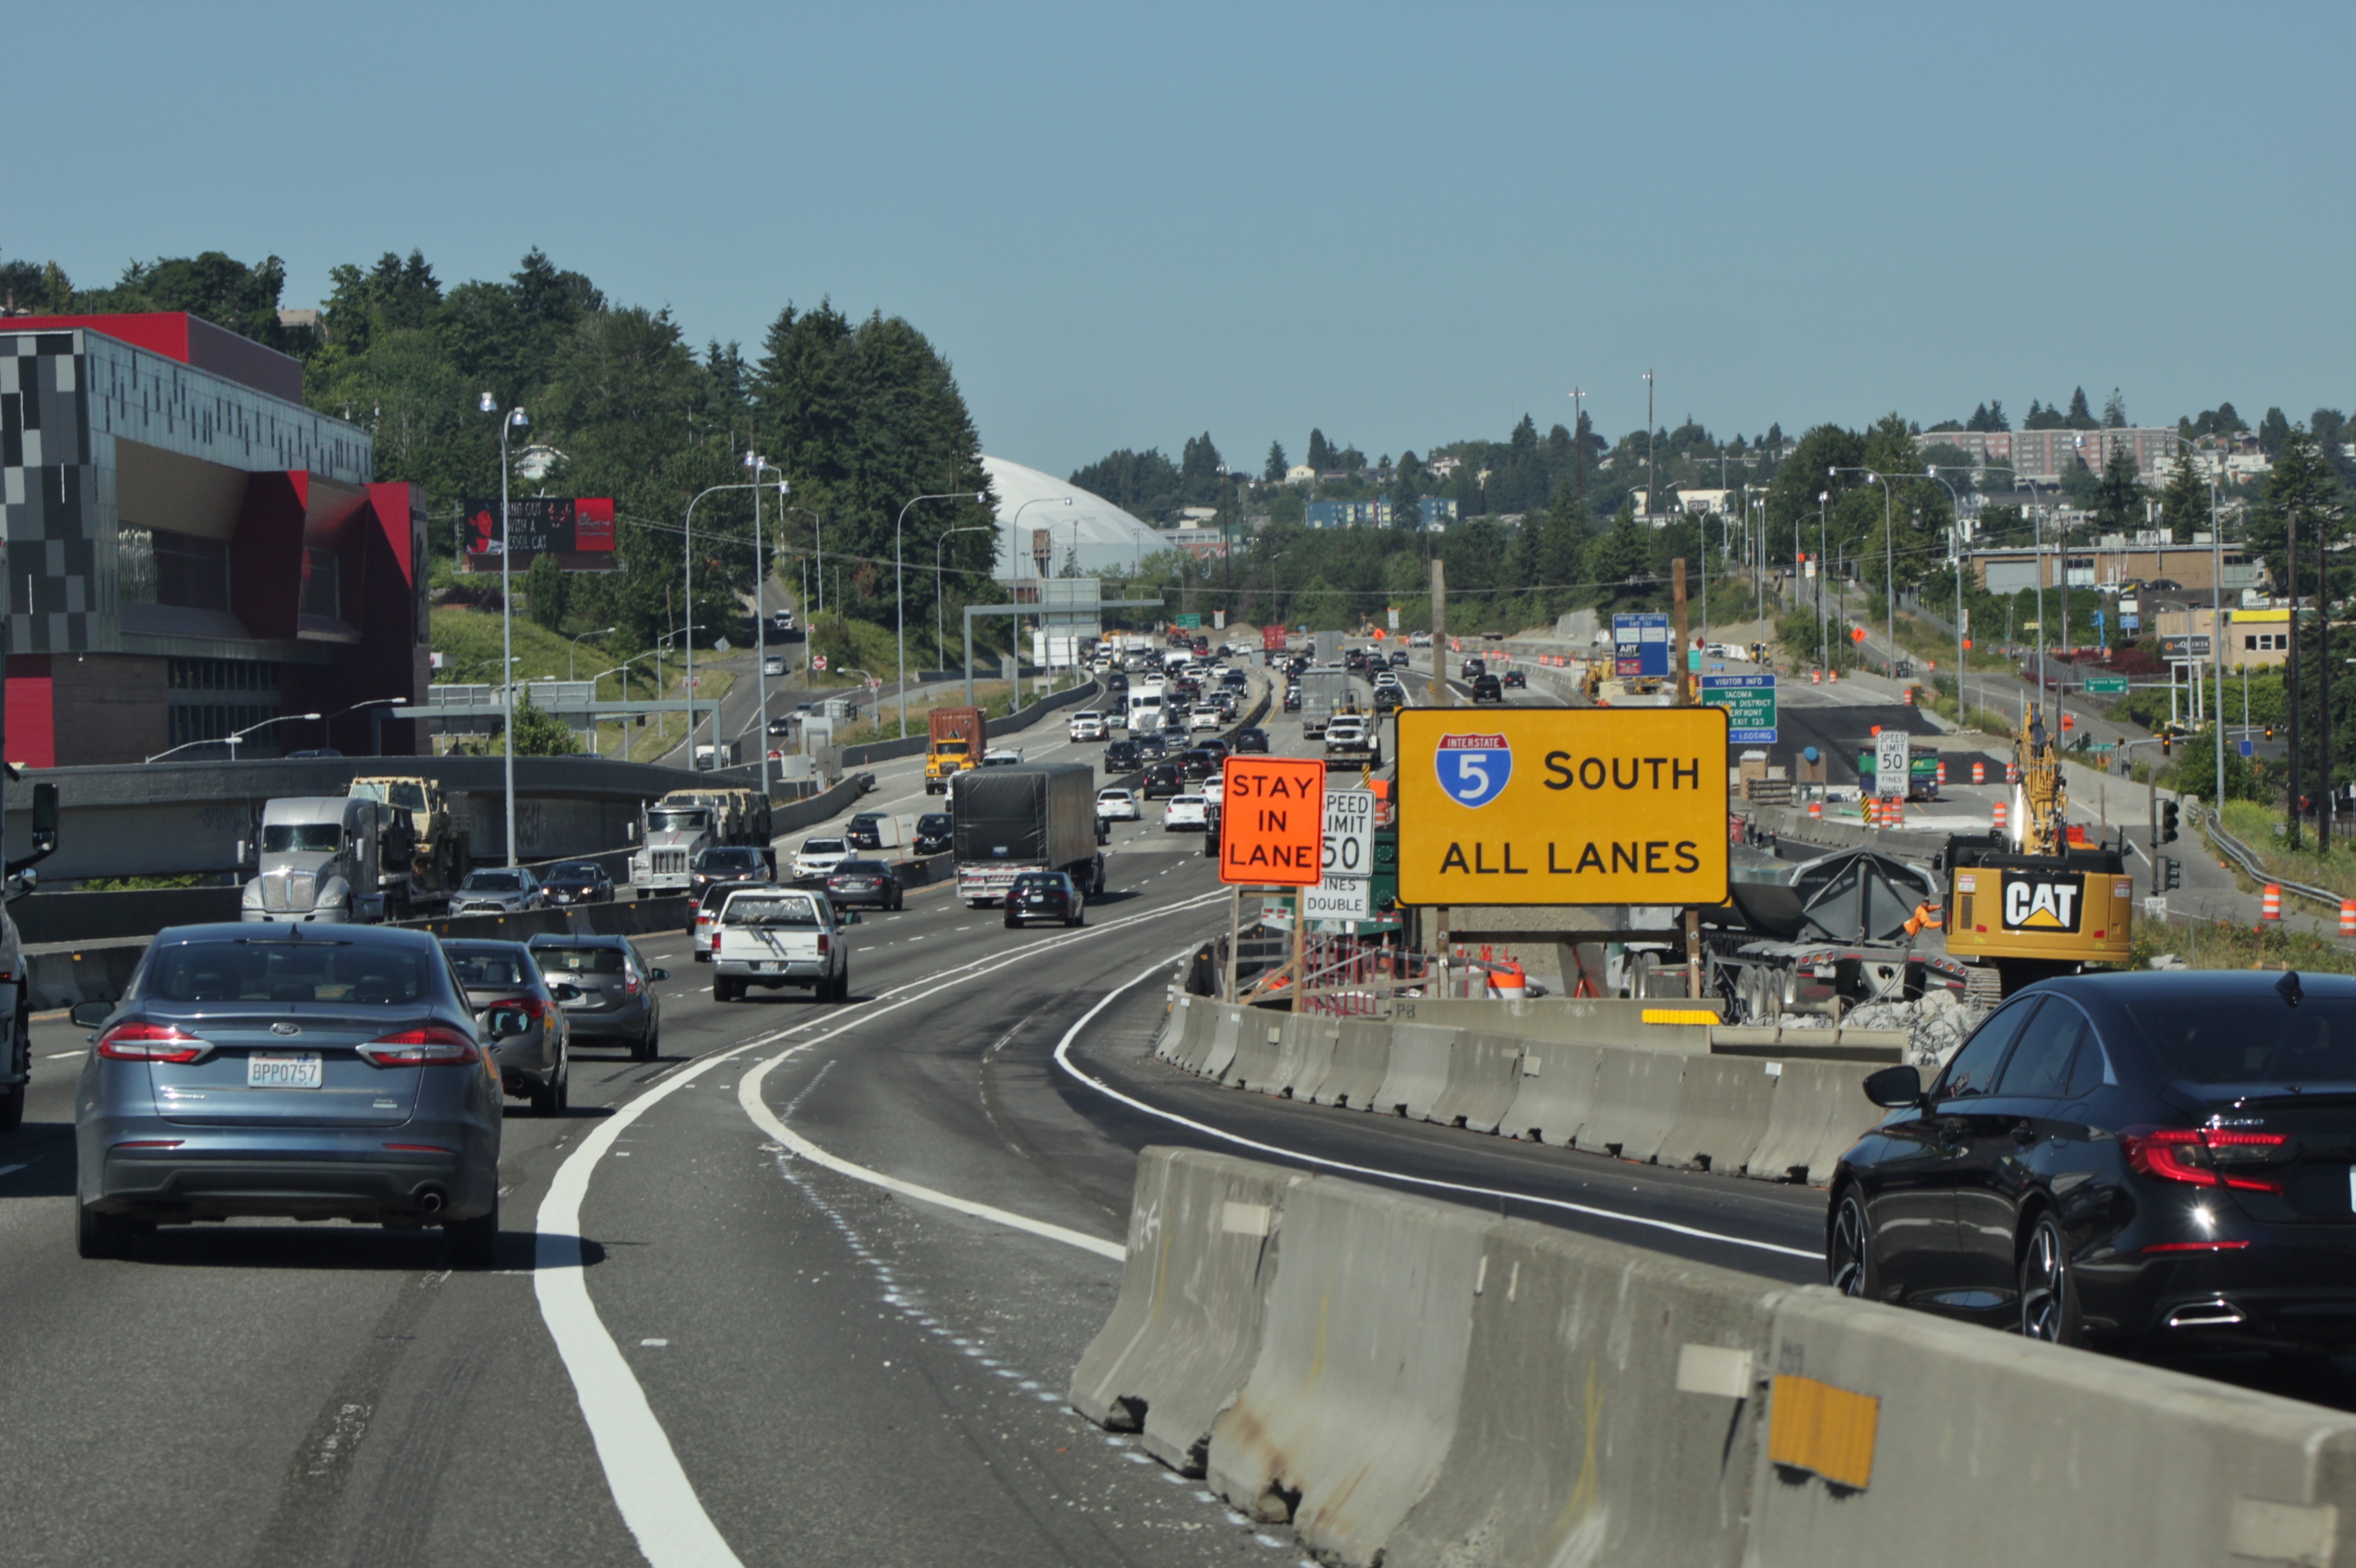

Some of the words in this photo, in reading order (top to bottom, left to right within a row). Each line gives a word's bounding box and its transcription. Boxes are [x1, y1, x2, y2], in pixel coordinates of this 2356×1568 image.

[500, 502, 522, 516] HANG
[525, 502, 542, 516] OUT
[530, 520, 535, 533] A
[508, 535, 529, 549] COOL
[532, 535, 546, 549] CAT
[1619, 644, 1638, 653] ART
[1715, 677, 1742, 686] VISITOR
[1746, 677, 1763, 685] INFO
[1724, 690, 1753, 699] TACOMA
[1739, 699, 1771, 708] DISTRICT
[1732, 718, 1748, 726] EXIT
[1739, 731, 1771, 740] LODGING
[1880, 733, 1906, 743] SPEED
[1447, 738, 1500, 748] INTERSTATE
[1880, 743, 1905, 752] LIMIT
[1883, 753, 1903, 770] 50
[1458, 754, 1489, 799] 5
[1543, 751, 1698, 790] SOUTH
[1232, 774, 1314, 799] STAY
[1324, 795, 1368, 813] PEED
[1259, 810, 1287, 832] IN
[1323, 815, 1366, 833] IMIT
[1230, 843, 1313, 868] LANE
[1322, 836, 1360, 869] 50
[1439, 841, 1528, 874] ALL
[1548, 841, 1700, 874] LANES
[1308, 897, 1362, 911] DOUBLE
[2006, 881, 2077, 927] CAT
[276, 1025, 294, 1033] Ford
[253, 1064, 316, 1082] BPP0757
